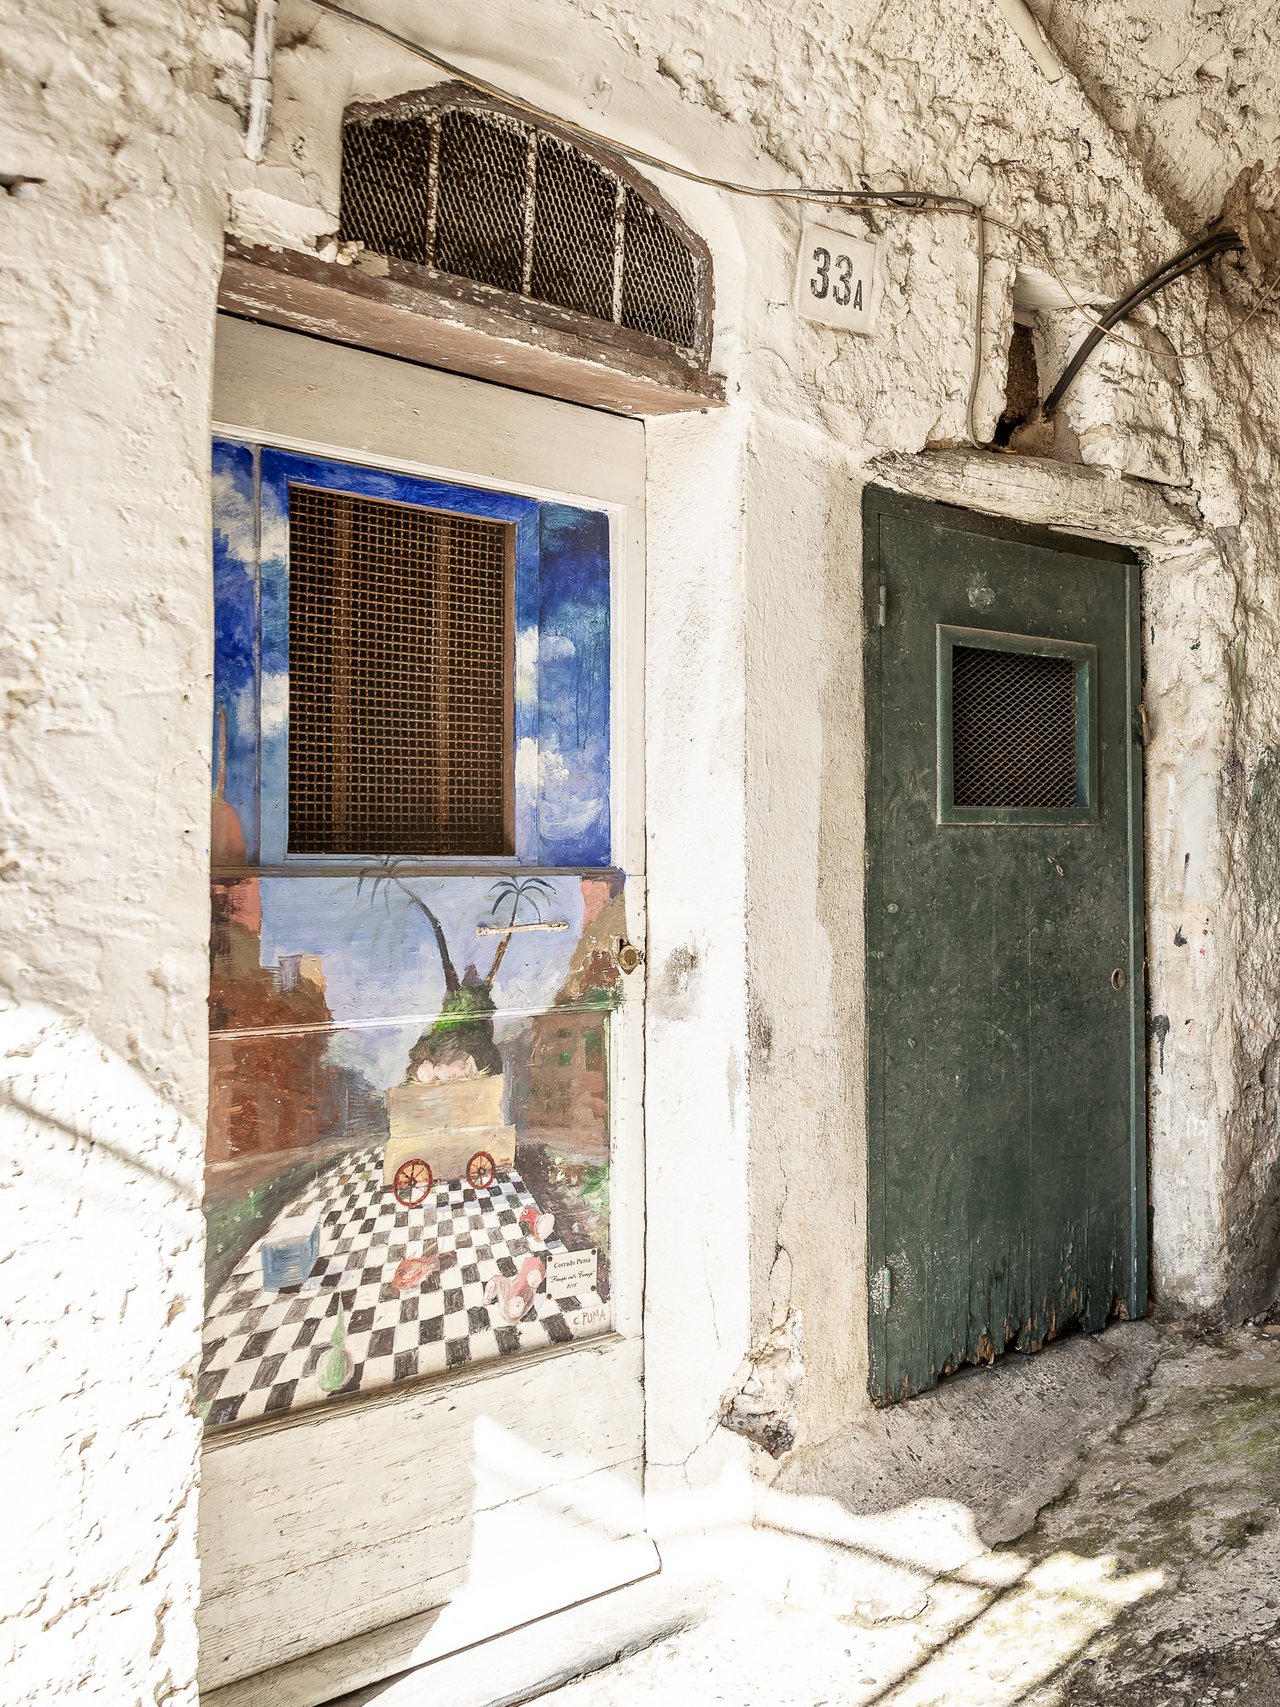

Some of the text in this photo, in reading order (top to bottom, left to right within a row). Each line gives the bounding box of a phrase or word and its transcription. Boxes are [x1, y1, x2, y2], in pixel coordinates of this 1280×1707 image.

[810, 247, 862, 311] 33A
[554, 1260, 575, 1268] Corrado
[582, 1309, 606, 1325] PUMA
